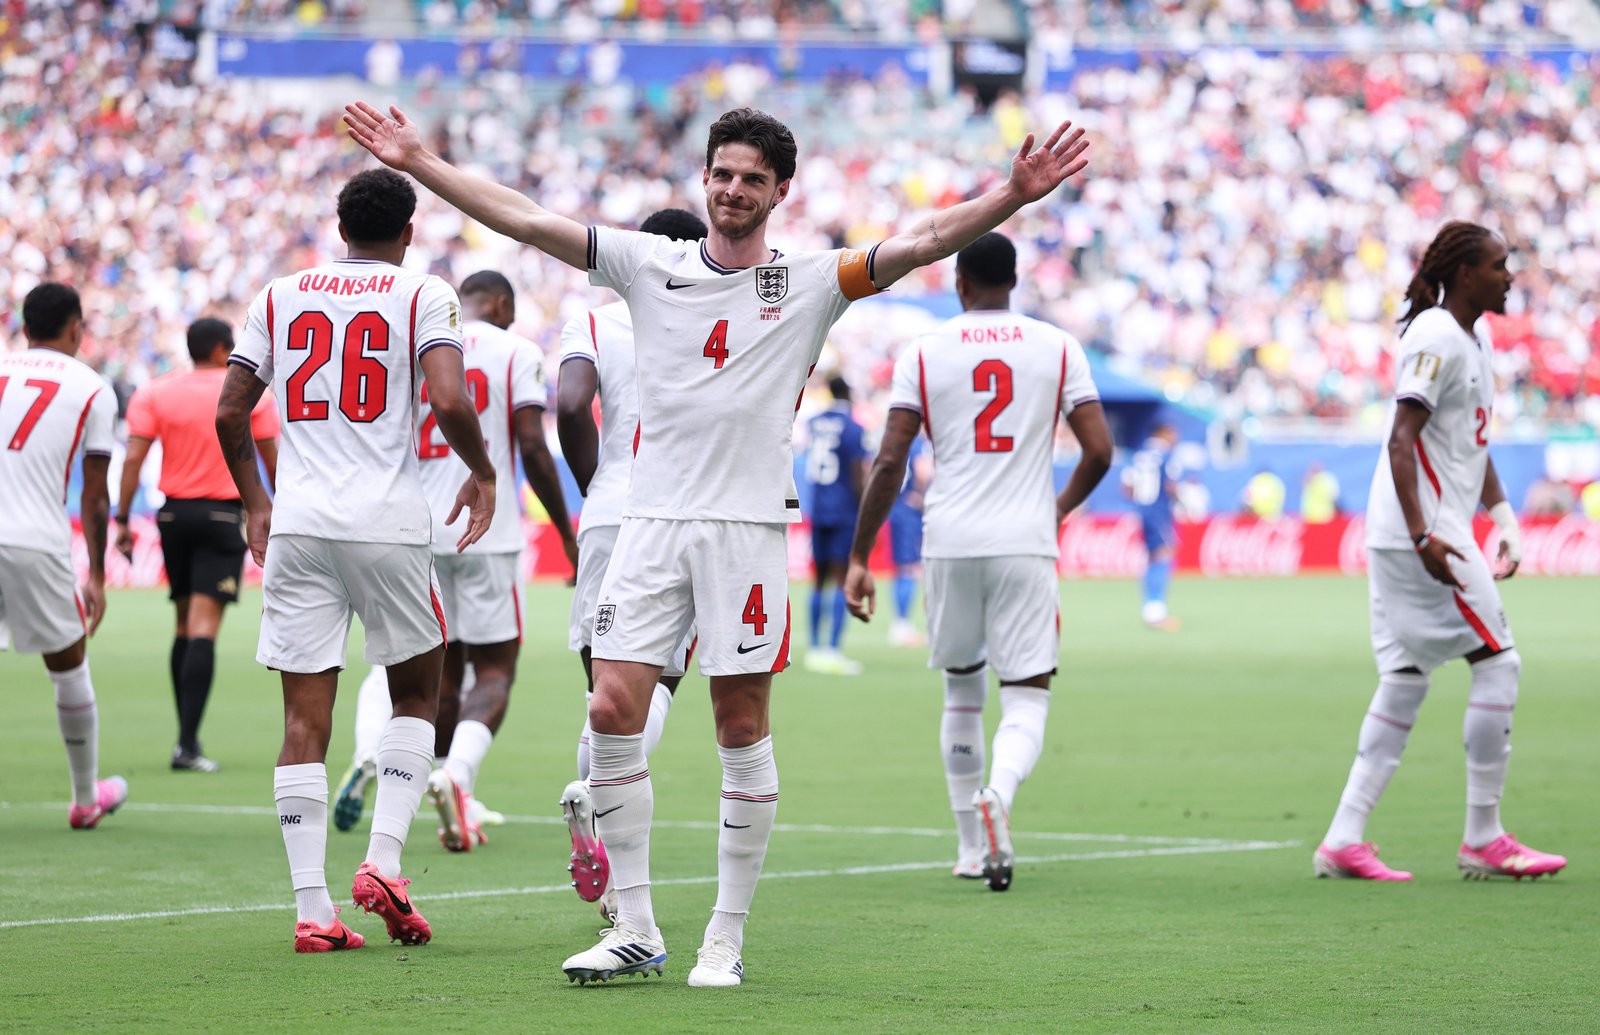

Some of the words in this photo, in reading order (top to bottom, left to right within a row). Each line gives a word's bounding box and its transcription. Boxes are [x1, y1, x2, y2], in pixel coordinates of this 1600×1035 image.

[298, 273, 395, 296] QUANSAH
[703, 319, 729, 369] 4
[961, 326, 1024, 343] KONSA
[286, 310, 389, 423] 26
[973, 359, 1014, 453] 2
[1475, 405, 1492, 448] 2
[742, 584, 767, 636] 4
[384, 767, 413, 781] ENG
[280, 814, 302, 825] ENG
